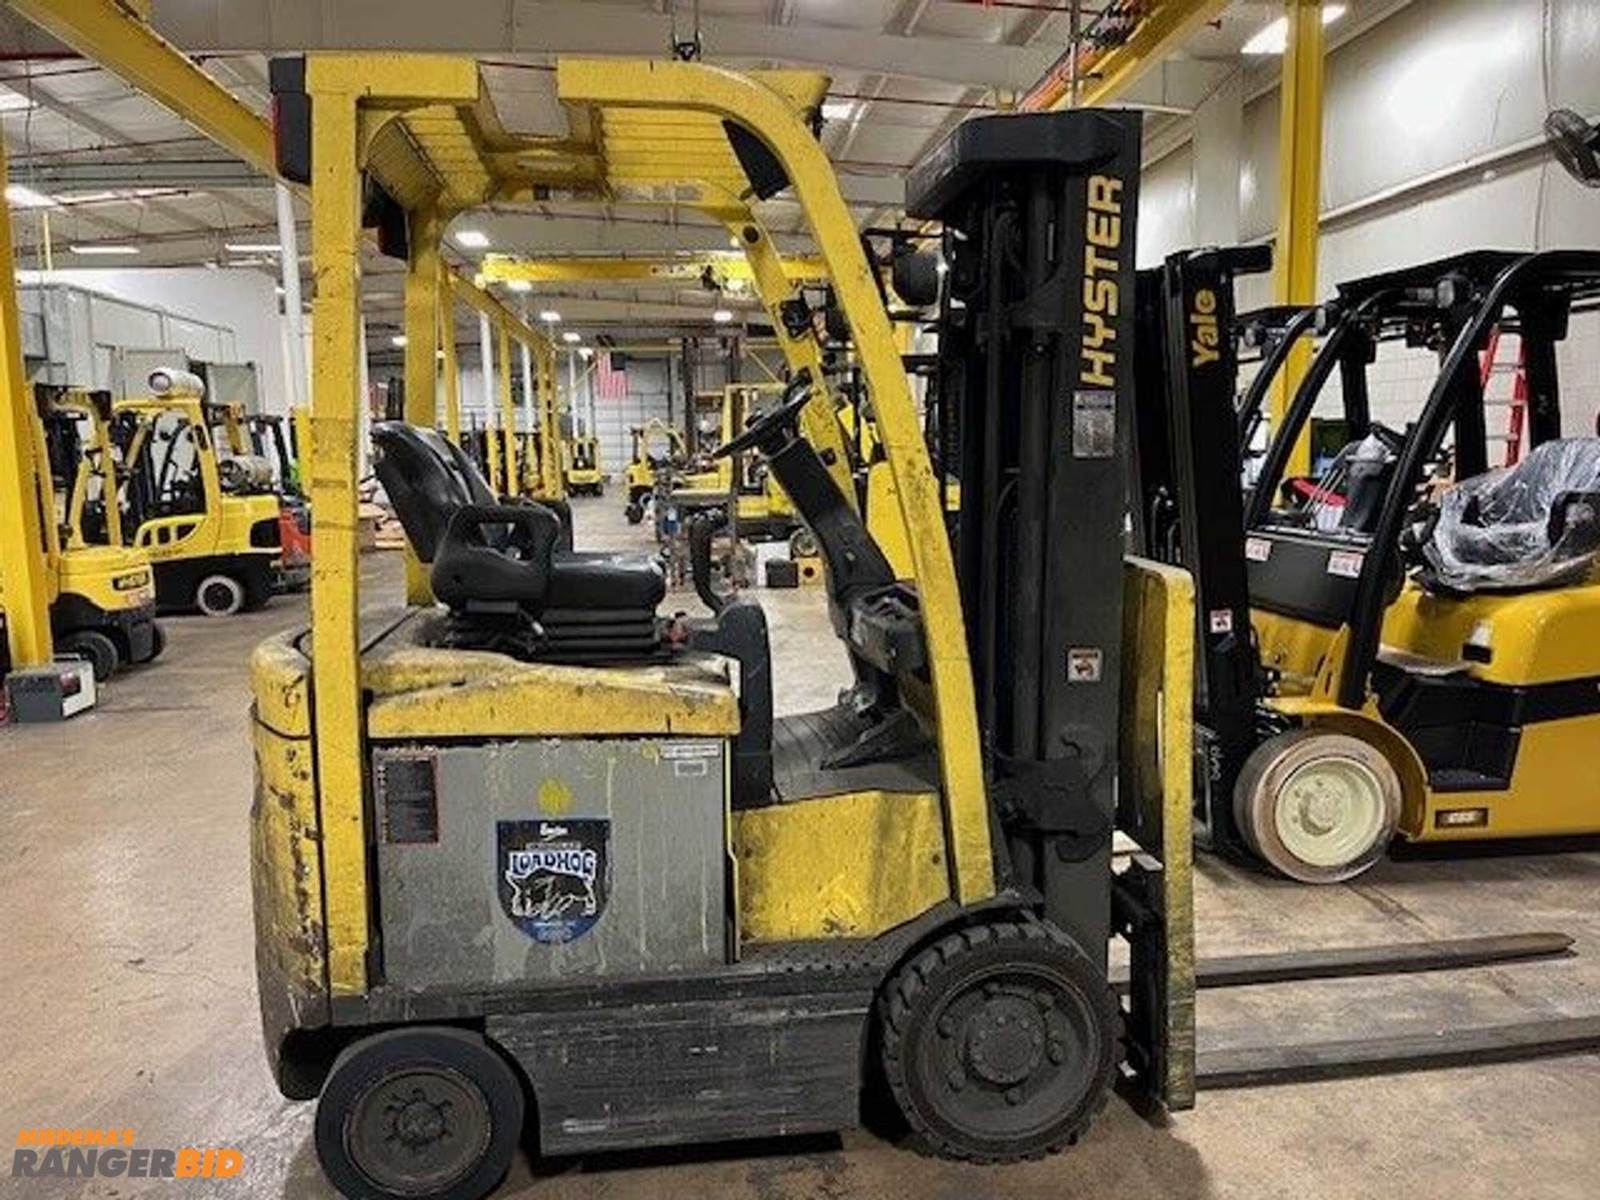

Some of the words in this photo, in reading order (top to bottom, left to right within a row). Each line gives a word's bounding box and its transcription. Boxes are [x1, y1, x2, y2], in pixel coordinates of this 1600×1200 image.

[1080, 174, 1123, 386] HYSTER
[1191, 289, 1220, 368] Yale
[510, 850, 597, 879] LOADHOG
